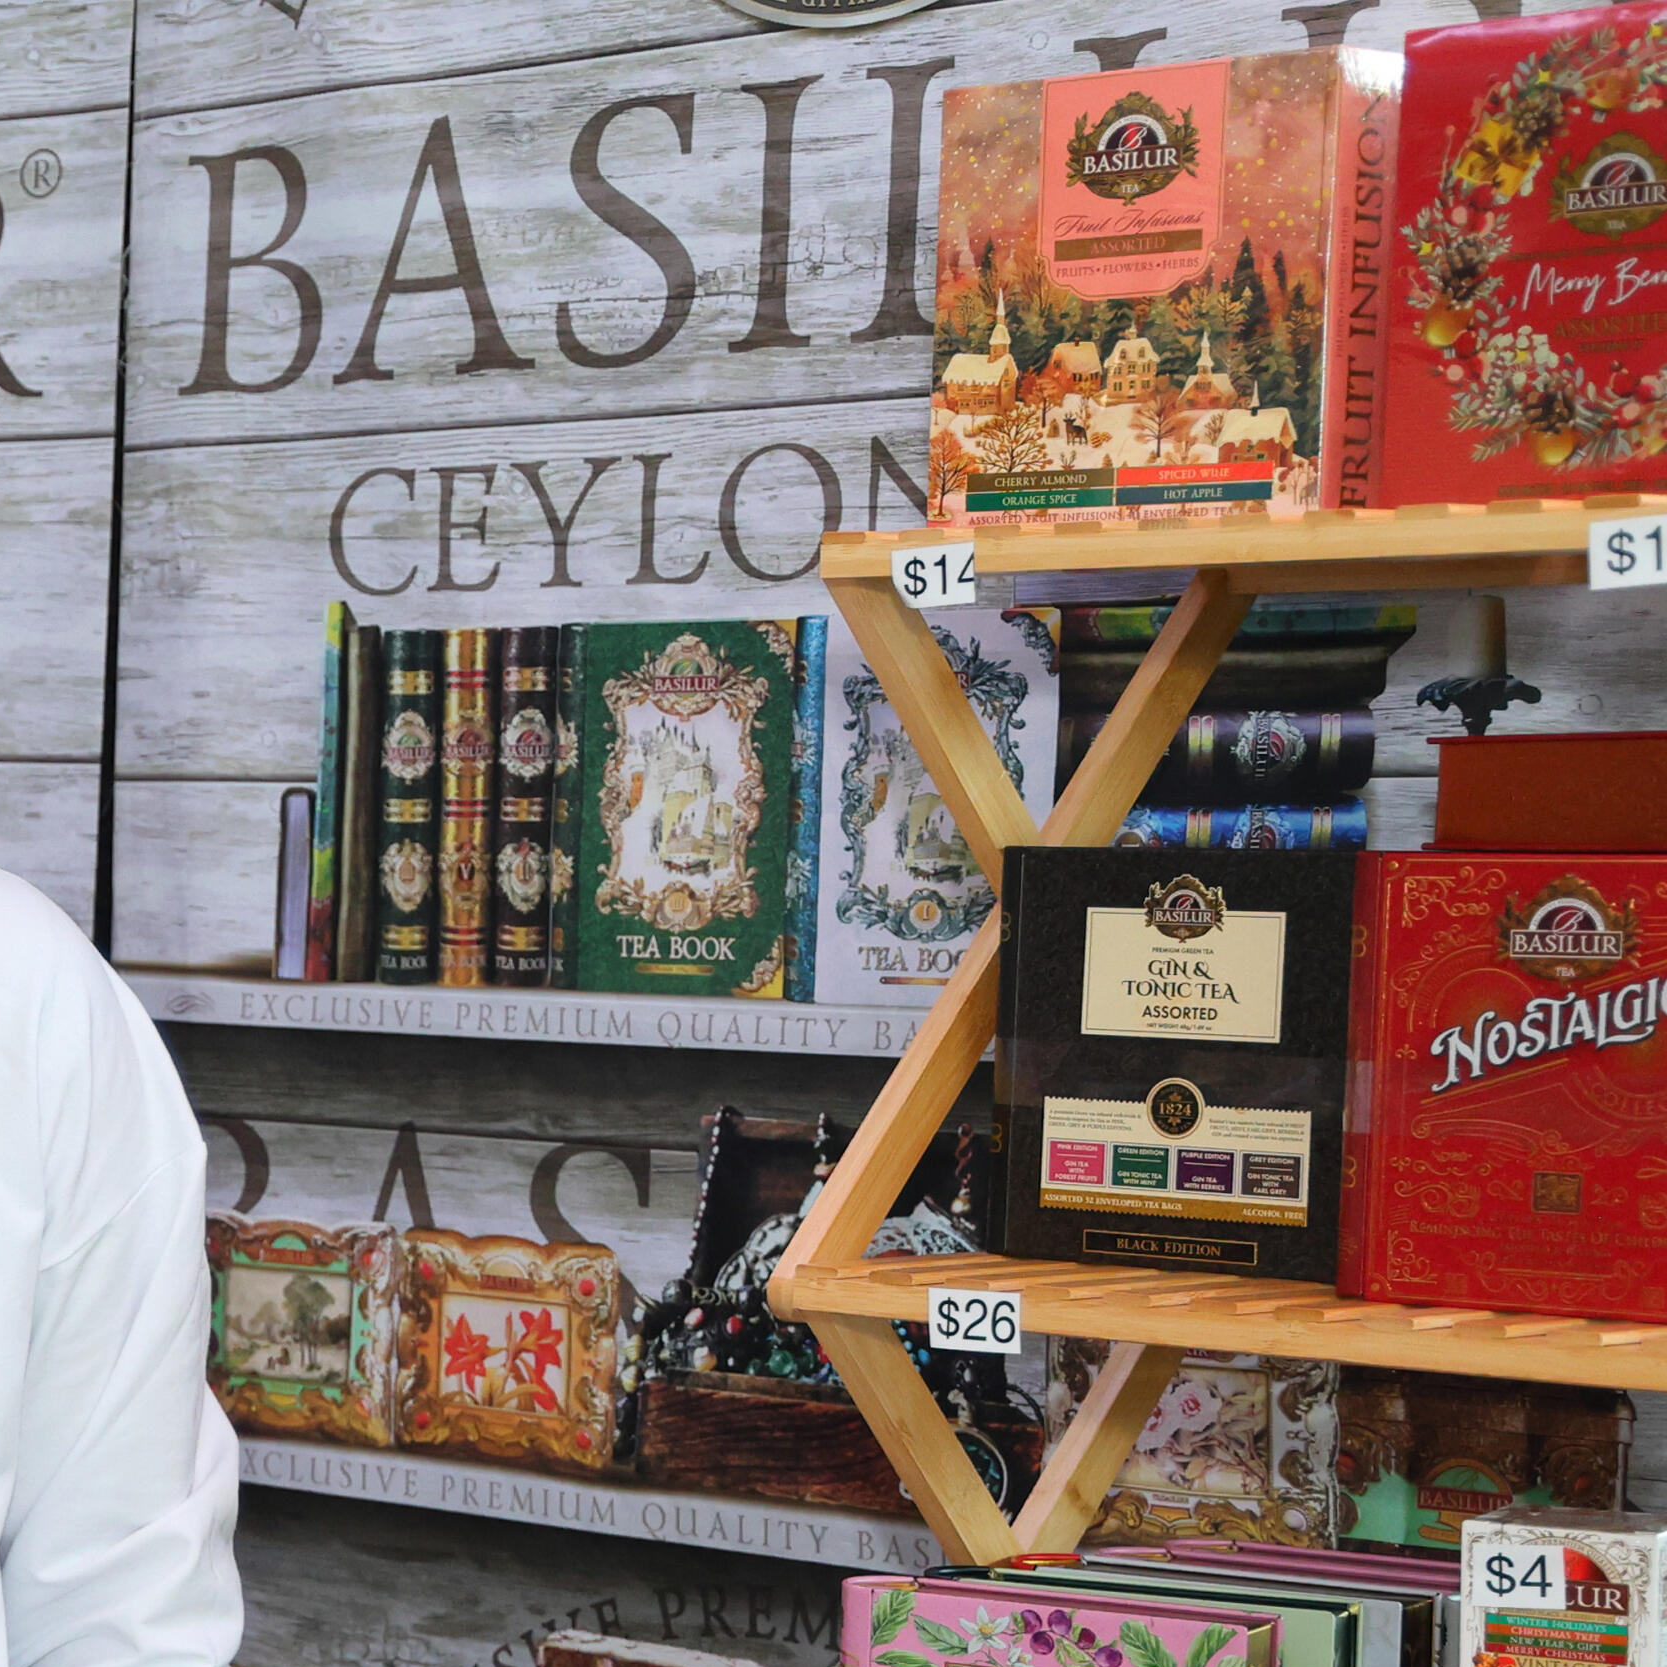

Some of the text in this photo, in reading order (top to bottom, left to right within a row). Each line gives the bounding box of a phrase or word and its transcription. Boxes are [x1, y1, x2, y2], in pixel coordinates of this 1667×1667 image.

[1082, 148, 1179, 175] BASILUR
[1120, 183, 1140, 194] TEA
[1568, 182, 1667, 211] BASILUR
[1090, 236, 1166, 255] ASSORTED
[1339, 355, 1379, 509] FRUIT
[994, 472, 1088, 488] CHERRY ALMOND
[1158, 466, 1231, 481] SPICED WINE
[1002, 492, 1078, 507] ORANGE SPICE
[1163, 486, 1224, 501] HOT APPLE
[653, 676, 718, 693] BASILUR
[1154, 910, 1214, 924] BASILUR
[616, 934, 736, 962] TEA BOOK
[1513, 932, 1619, 957] BASILUR
[1148, 958, 1215, 980] GIN &
[1555, 966, 1576, 978] TEA
[1121, 978, 1240, 1004] TONIC TEA
[239, 991, 435, 1032] EXCLUSIVE
[454, 999, 639, 1040] PREMIUM
[657, 1008, 847, 1051] QUALITY
[1142, 1004, 1218, 1021] ASSORTED
[1159, 1101, 1192, 1118] 1824
[1116, 1237, 1222, 1258] BLACK EDITION
[936, 1298, 1018, 1346] $26
[439, 1474, 619, 1529] PREMIUM
[642, 1500, 832, 1559] QUALITY
[1485, 1551, 1554, 1598] $4
[1506, 1615, 1607, 1634] WINTER HOLIDAYS
[1509, 1626, 1602, 1643] CHRISTMAS TREE
[1505, 1645, 1607, 1663] MERRY CHRISTMAS
